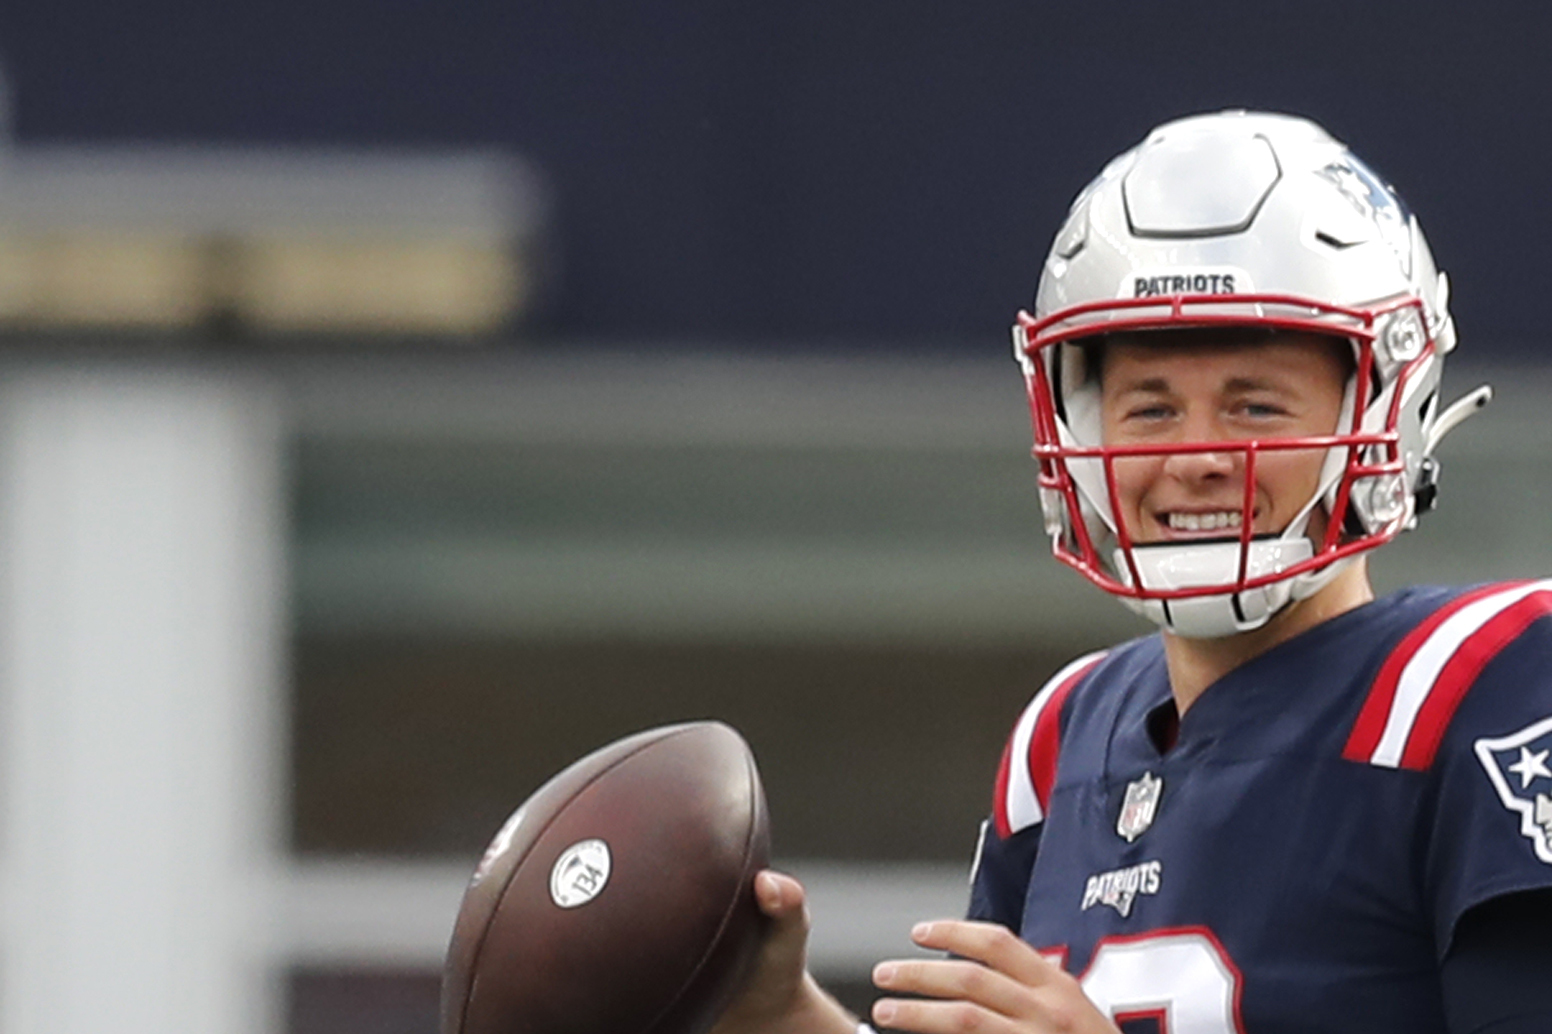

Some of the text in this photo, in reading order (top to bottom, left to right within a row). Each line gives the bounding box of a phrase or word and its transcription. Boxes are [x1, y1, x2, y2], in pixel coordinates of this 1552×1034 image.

[1134, 274, 1235, 298] PATRIOTS
[571, 863, 604, 896] 134
[1081, 860, 1161, 911] PATRIOTS
